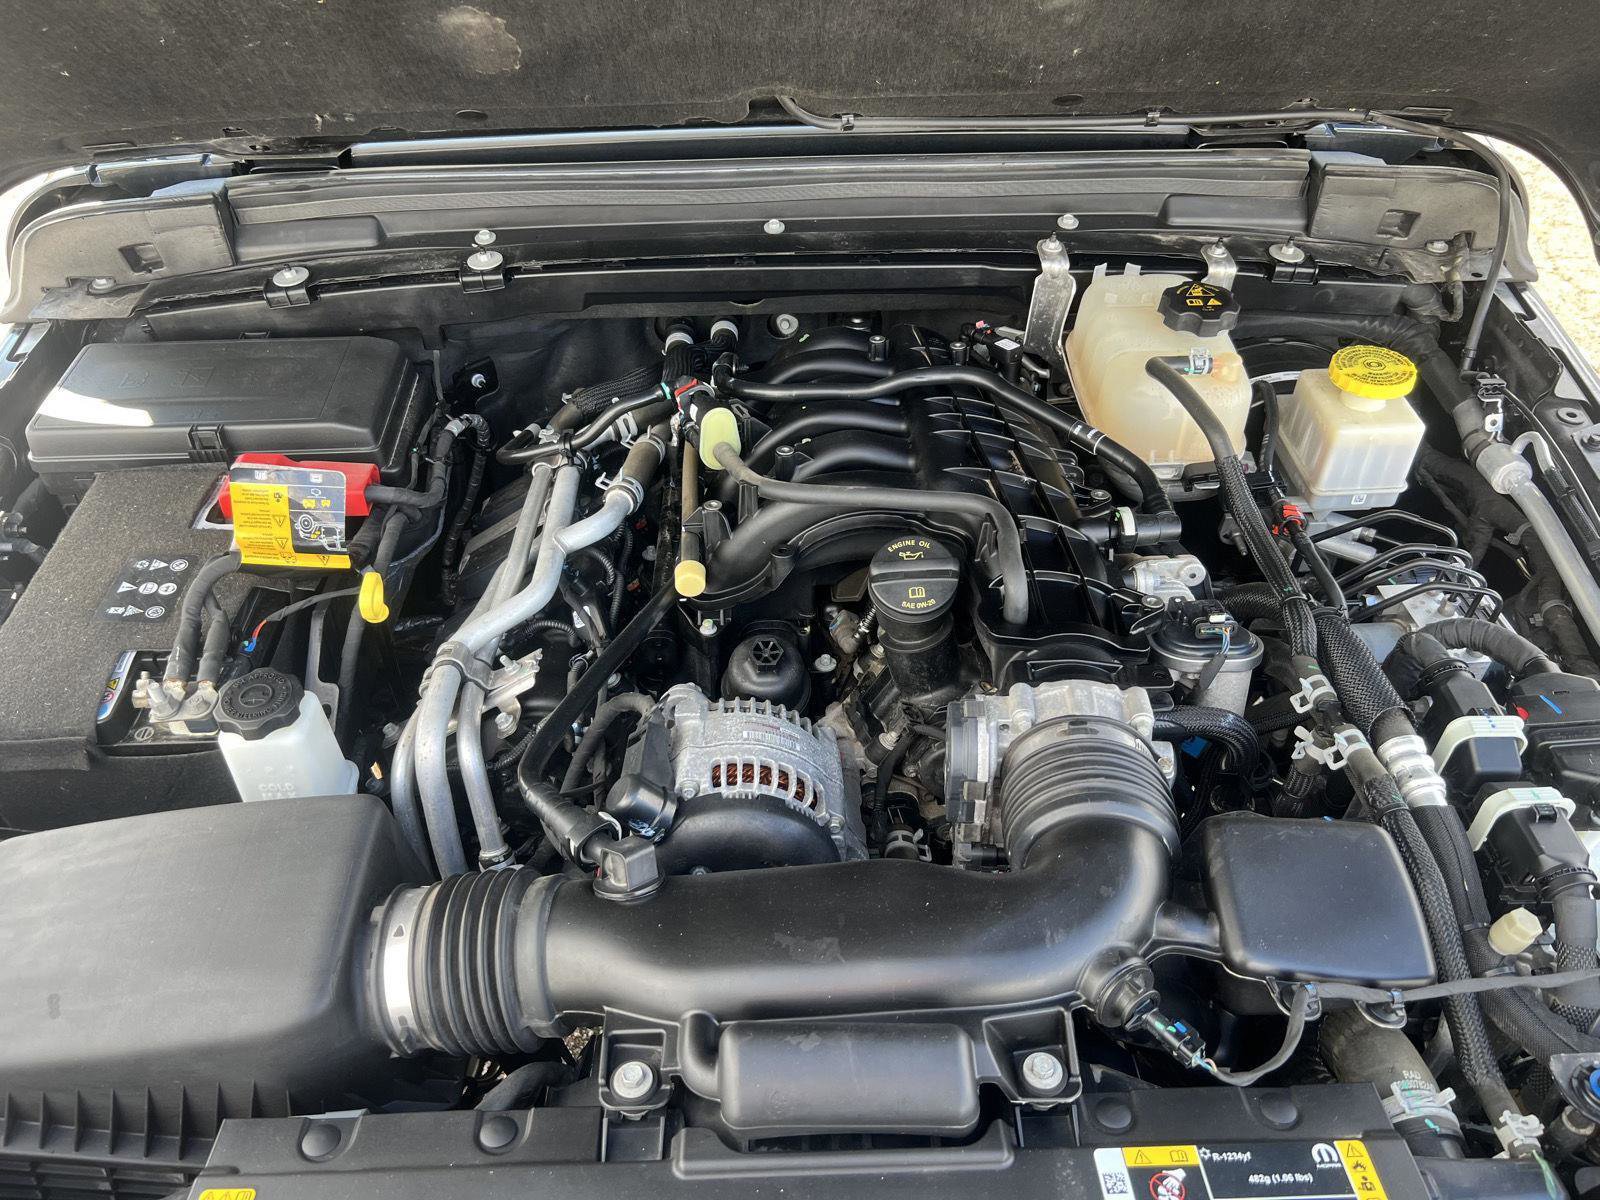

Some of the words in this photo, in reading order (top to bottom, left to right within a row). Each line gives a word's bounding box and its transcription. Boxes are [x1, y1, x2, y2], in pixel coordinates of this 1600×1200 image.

[887, 539, 916, 552] ENGINE
[918, 540, 931, 549] OIL
[901, 600, 915, 609] SAE
[916, 598, 936, 609] 0W-20
